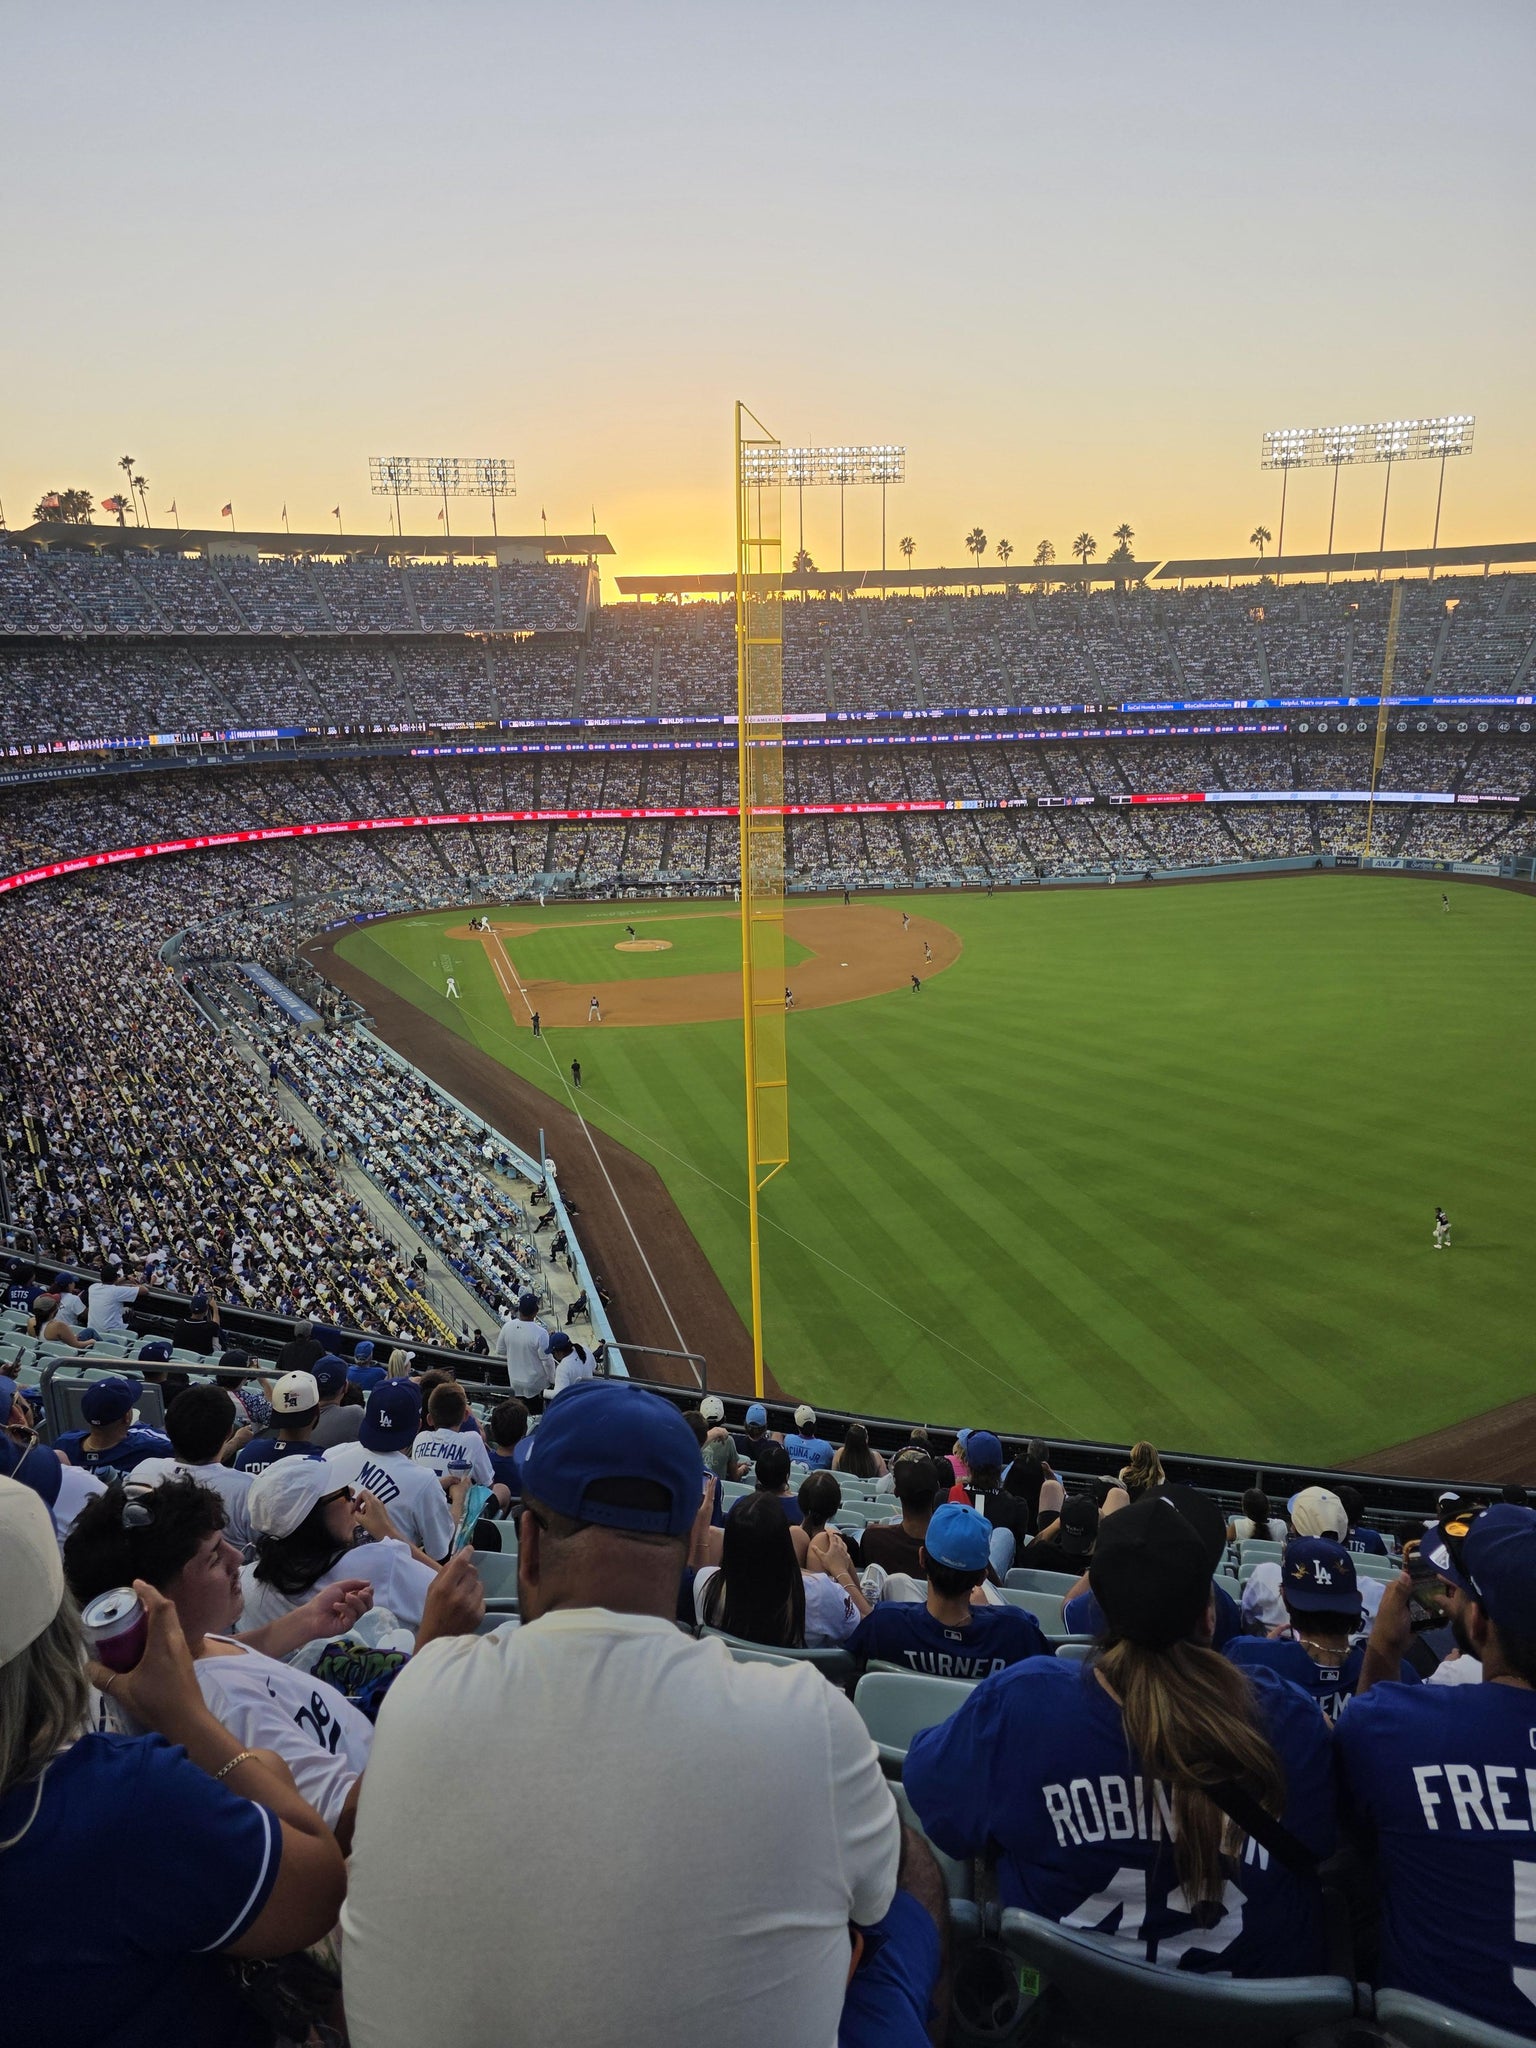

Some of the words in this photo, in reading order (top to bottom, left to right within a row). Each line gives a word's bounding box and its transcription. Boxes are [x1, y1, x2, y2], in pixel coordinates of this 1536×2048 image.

[592, 810, 622, 818] Budweiser
[372, 820, 404, 829] Budweiser
[427, 816, 459, 825] Budweiser
[262, 829, 294, 839] Budweiser
[316, 824, 349, 833] Budweiser
[208, 835, 239, 846] Budweiser
[157, 842, 187, 853] Budweiser
[108, 852, 137, 864] Budweiser
[63, 861, 89, 873] Budweiser
[1375, 860, 1392, 868] ANA
[11, 1290, 29, 1299] BETTS
[380, 1410, 392, 1427] LA
[415, 1442, 467, 1461] FREEMAN
[787, 1446, 809, 1459] CUNA
[1313, 1560, 1333, 1585] LA
[1042, 1775, 1270, 1871] ROBIN
